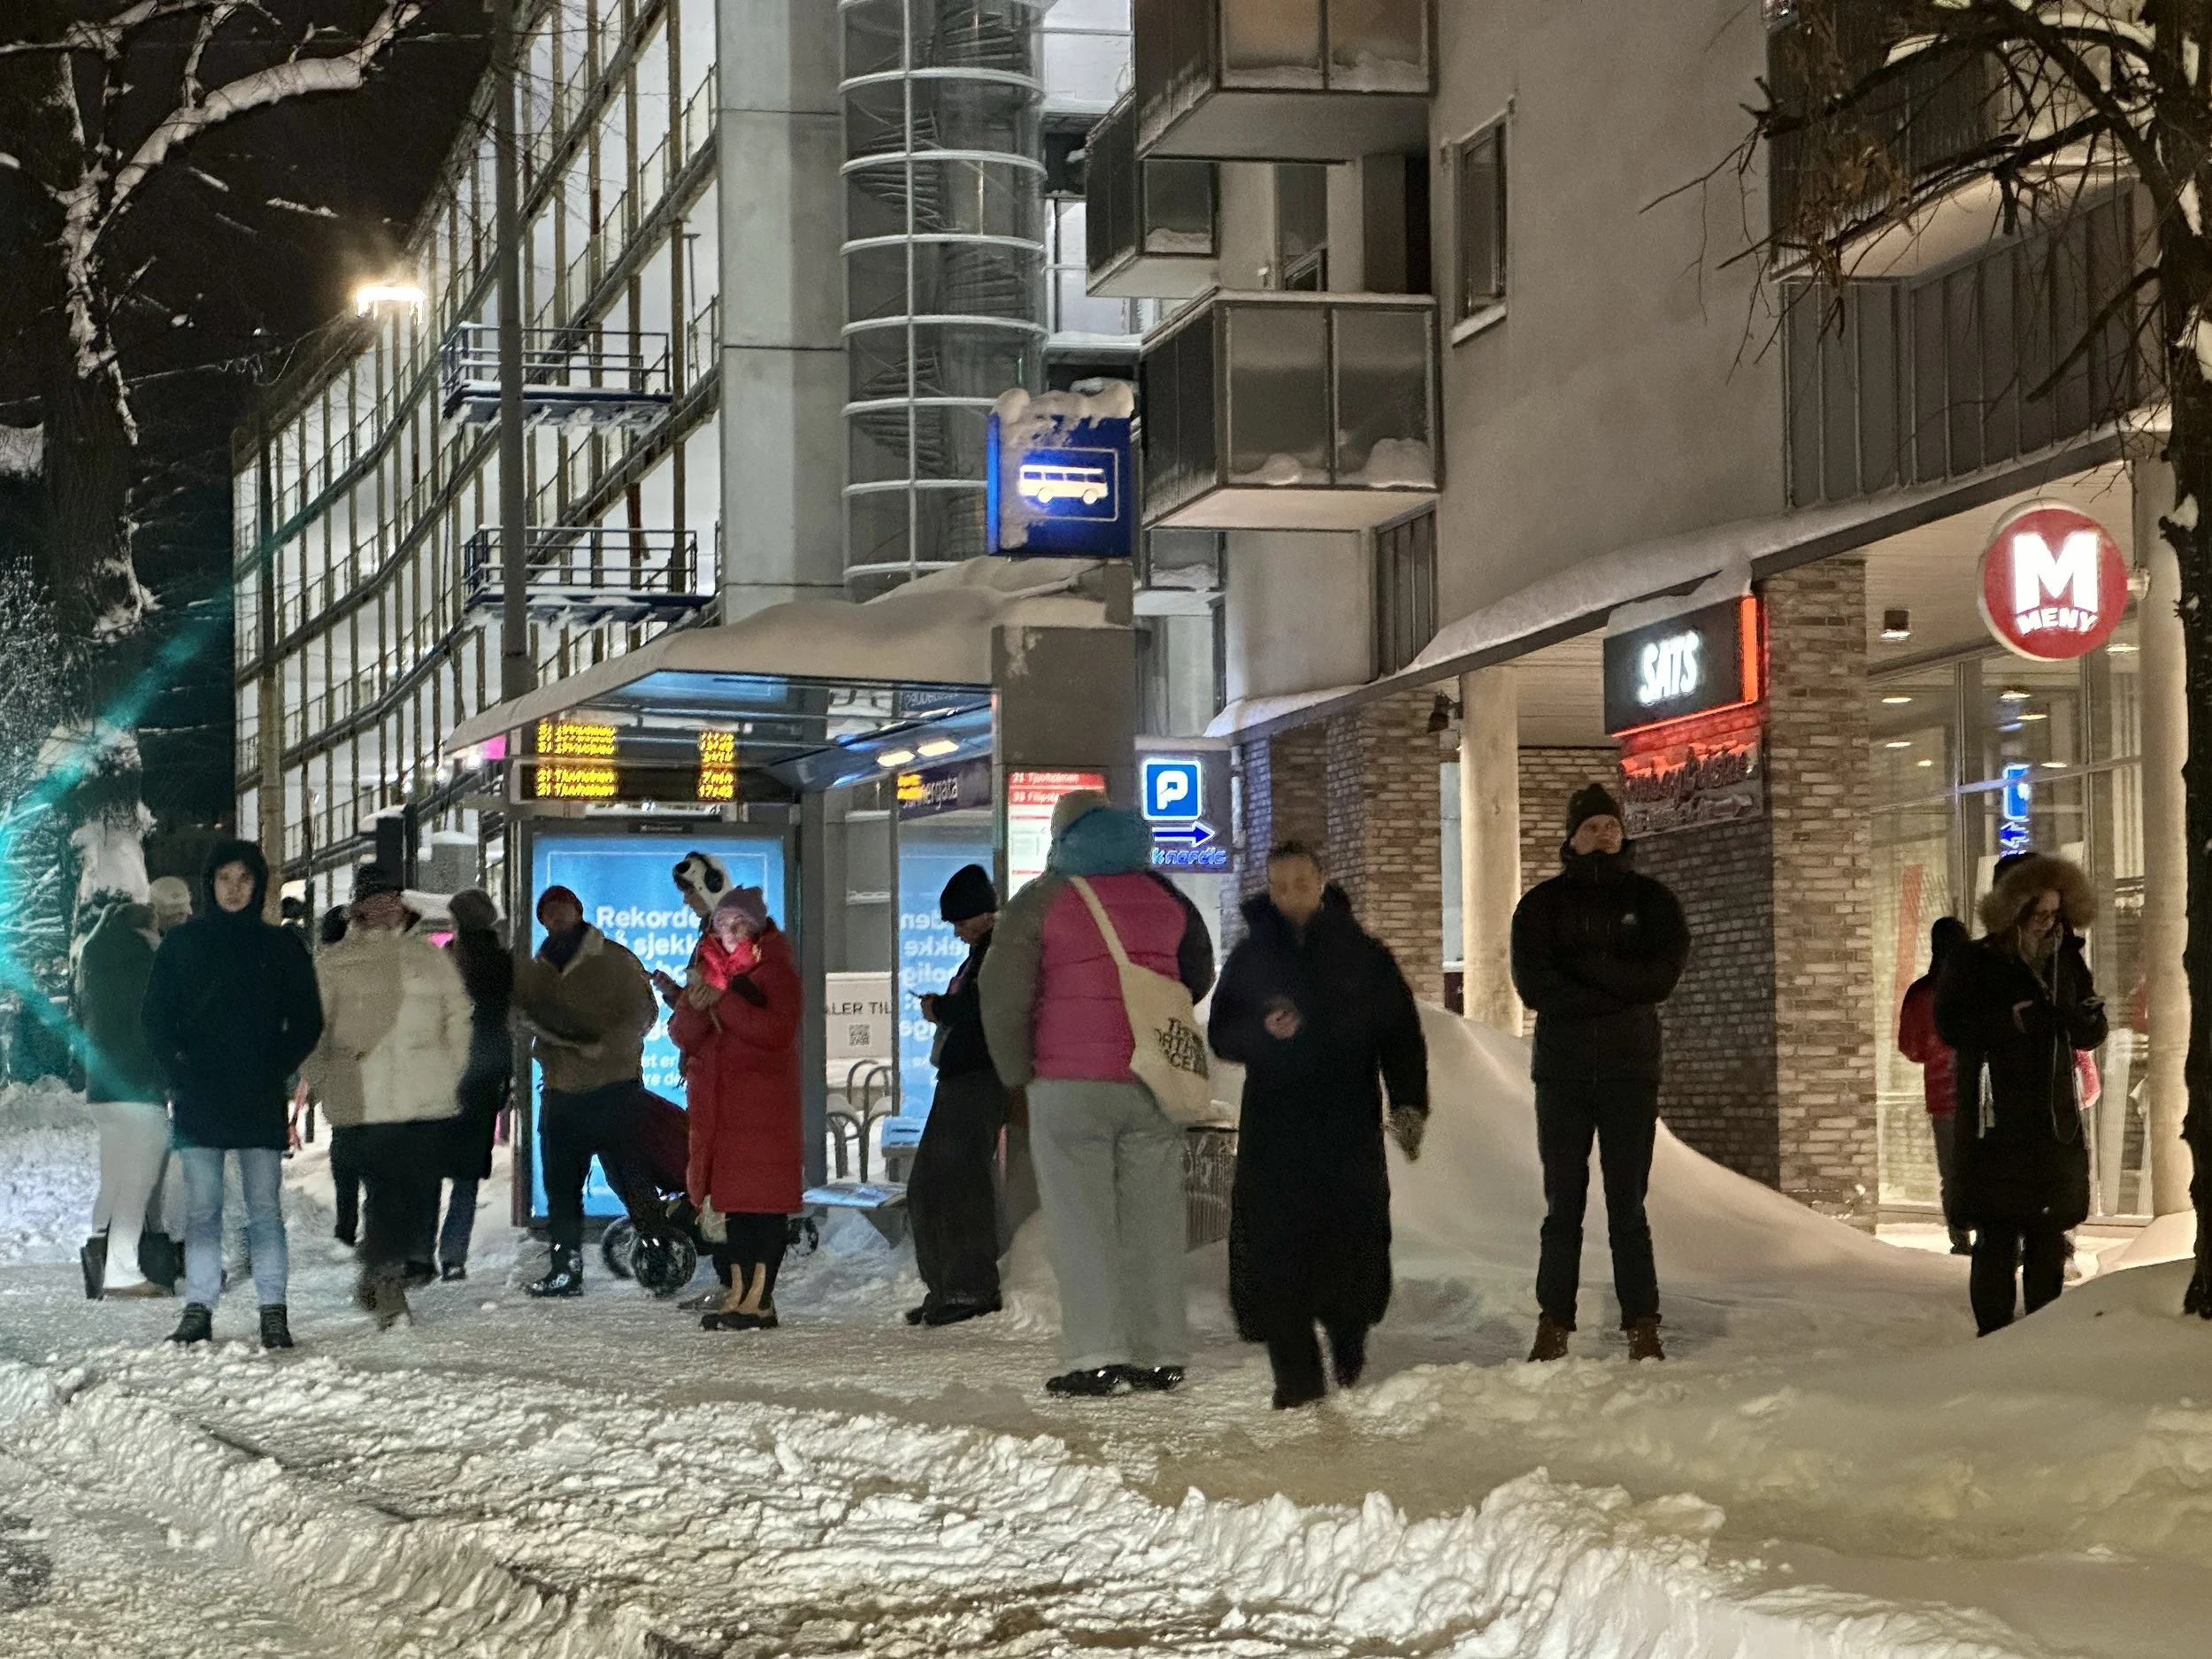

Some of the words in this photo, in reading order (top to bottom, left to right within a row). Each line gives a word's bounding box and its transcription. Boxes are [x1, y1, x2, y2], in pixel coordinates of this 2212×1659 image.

[2013, 531, 2101, 613] M
[2016, 607, 2098, 635] MENY
[1639, 629, 1700, 703] SATS
[1012, 772, 1025, 783] 21
[1156, 770, 1189, 810] P
[595, 905, 702, 929] Rekorde
[634, 932, 699, 961] sjekk
[825, 1002, 864, 1016] LER
[868, 1001, 892, 1015] TIL
